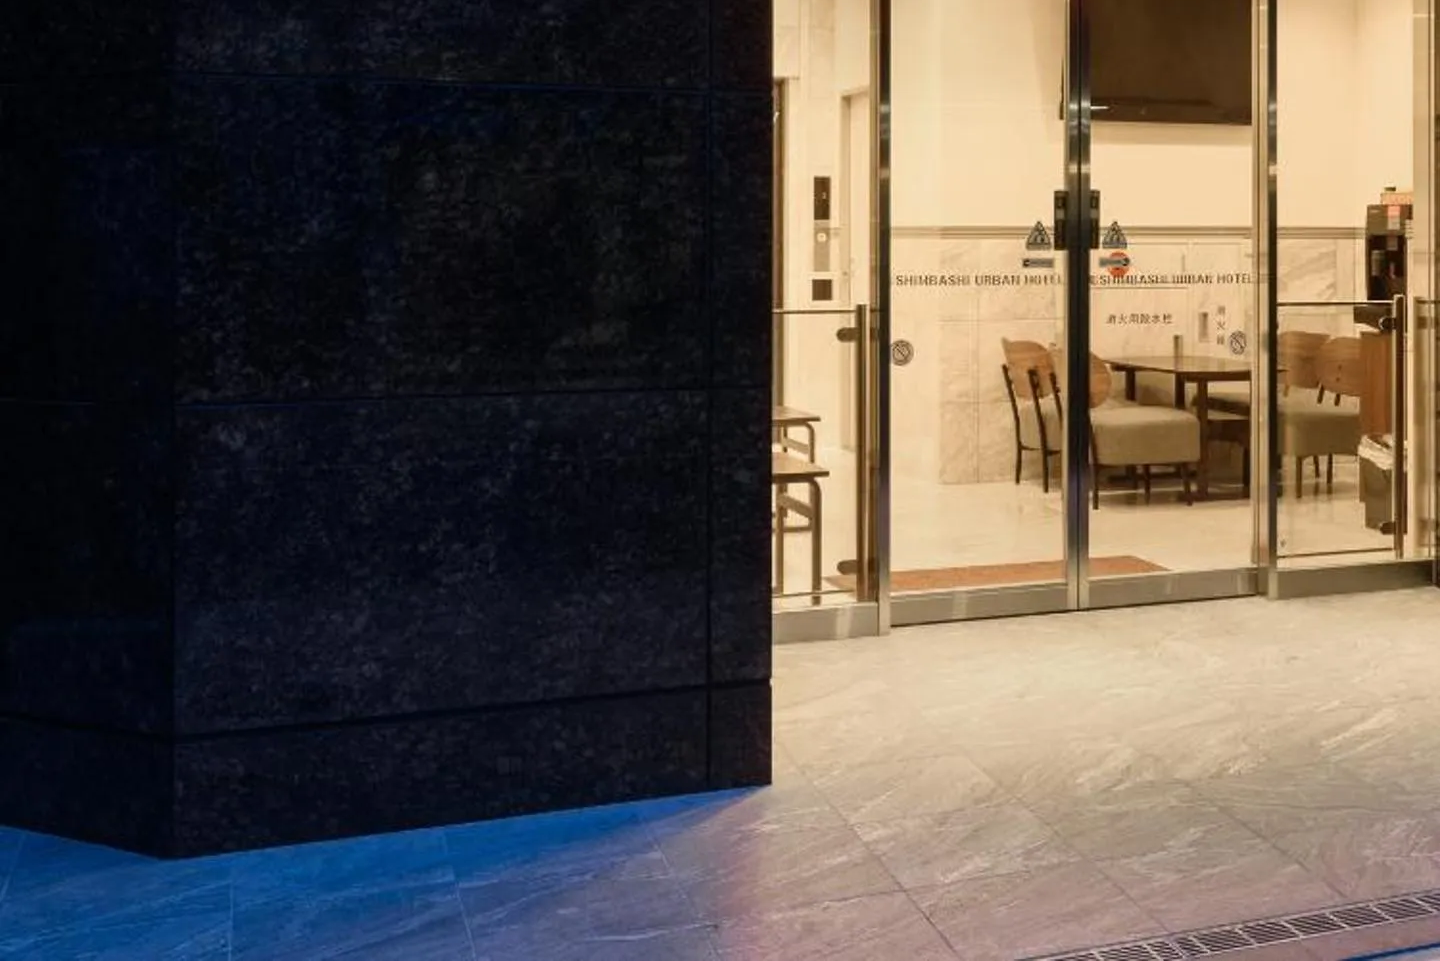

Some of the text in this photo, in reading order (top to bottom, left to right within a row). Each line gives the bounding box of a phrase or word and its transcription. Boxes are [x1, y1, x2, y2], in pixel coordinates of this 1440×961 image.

[895, 274, 970, 287] SHIMBASHI
[974, 274, 1021, 287] URBAN
[1216, 272, 1252, 284] HOTEL
